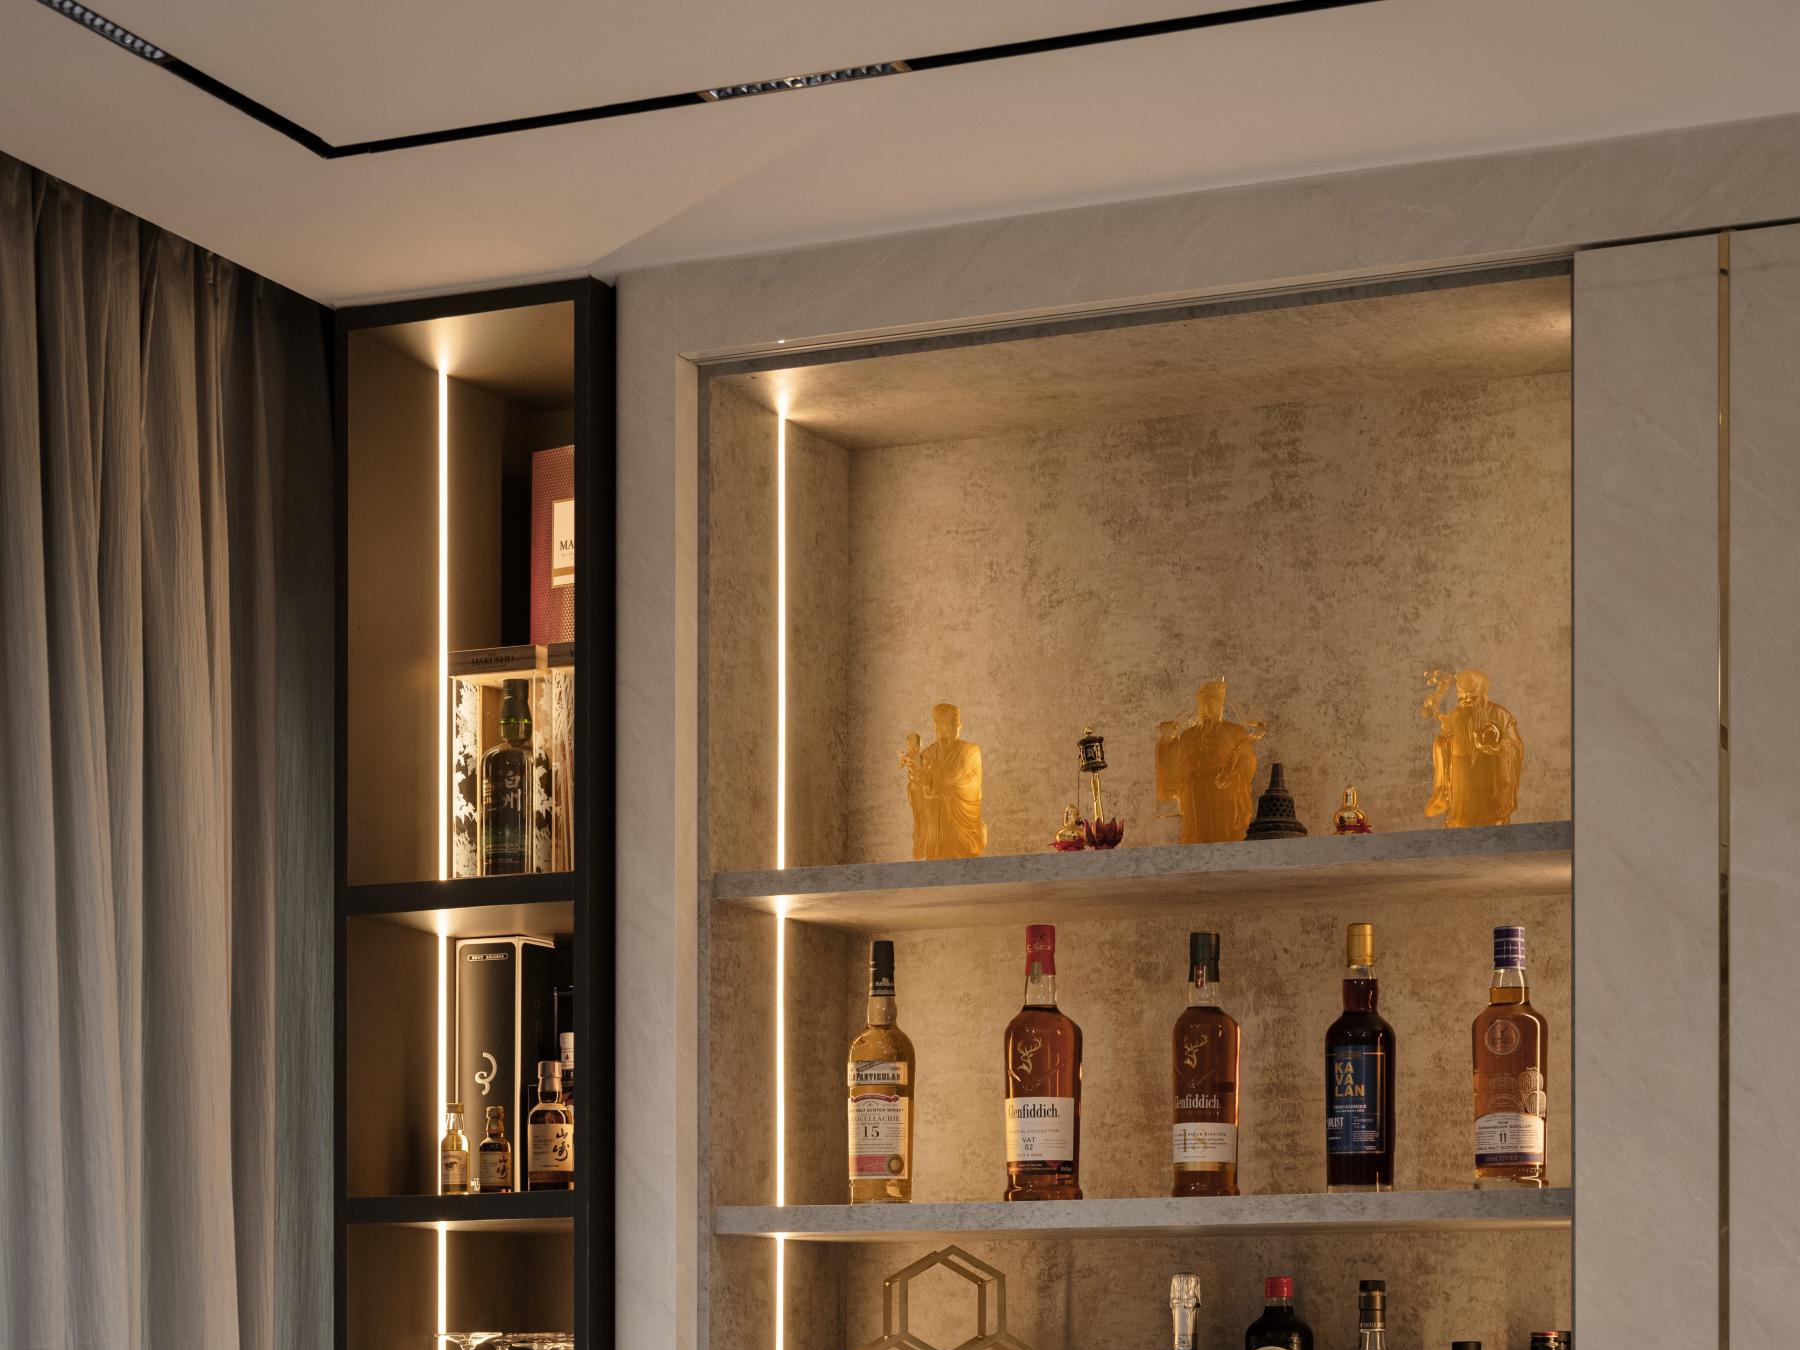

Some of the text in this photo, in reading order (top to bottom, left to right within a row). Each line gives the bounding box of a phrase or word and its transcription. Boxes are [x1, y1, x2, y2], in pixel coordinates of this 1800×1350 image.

[1334, 1062, 1354, 1073] KA
[1335, 1073, 1354, 1085] VA
[1335, 1084, 1365, 1097] LAN
[863, 1125, 880, 1139] 15
[1499, 1132, 1507, 1143] 11
